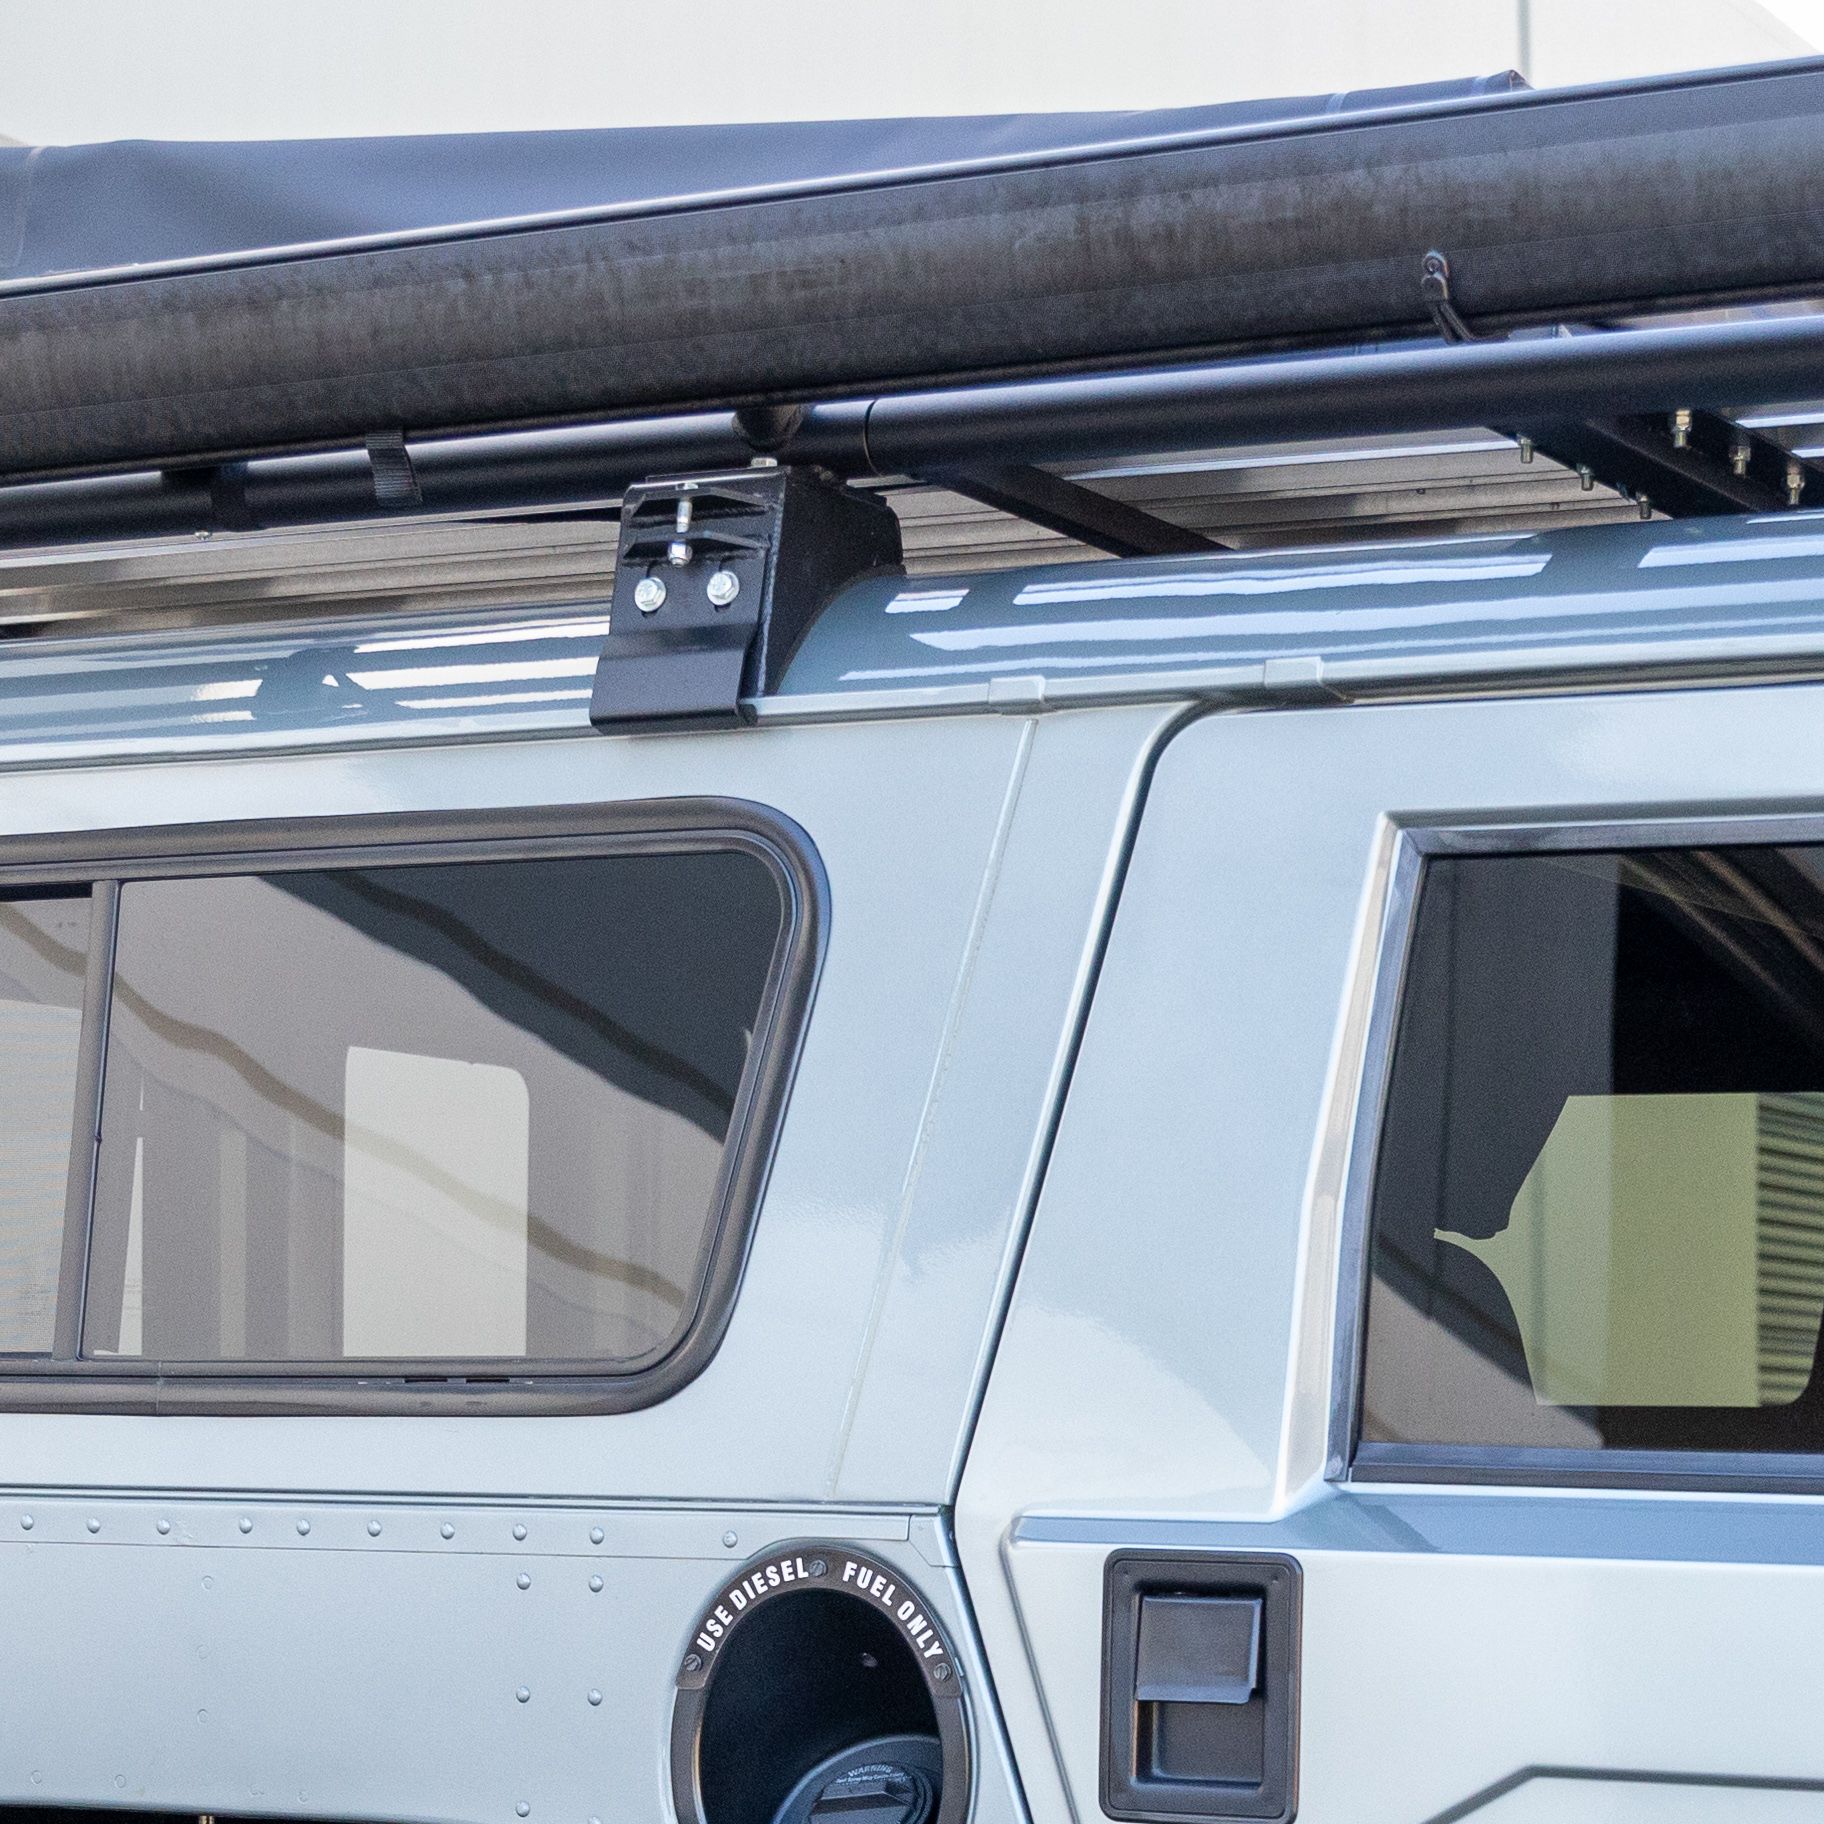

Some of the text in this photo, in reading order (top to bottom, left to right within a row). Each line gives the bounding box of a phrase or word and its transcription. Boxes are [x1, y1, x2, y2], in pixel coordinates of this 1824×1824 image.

[696, 1557, 945, 1660] USE DIESEL FUEL ONLY
